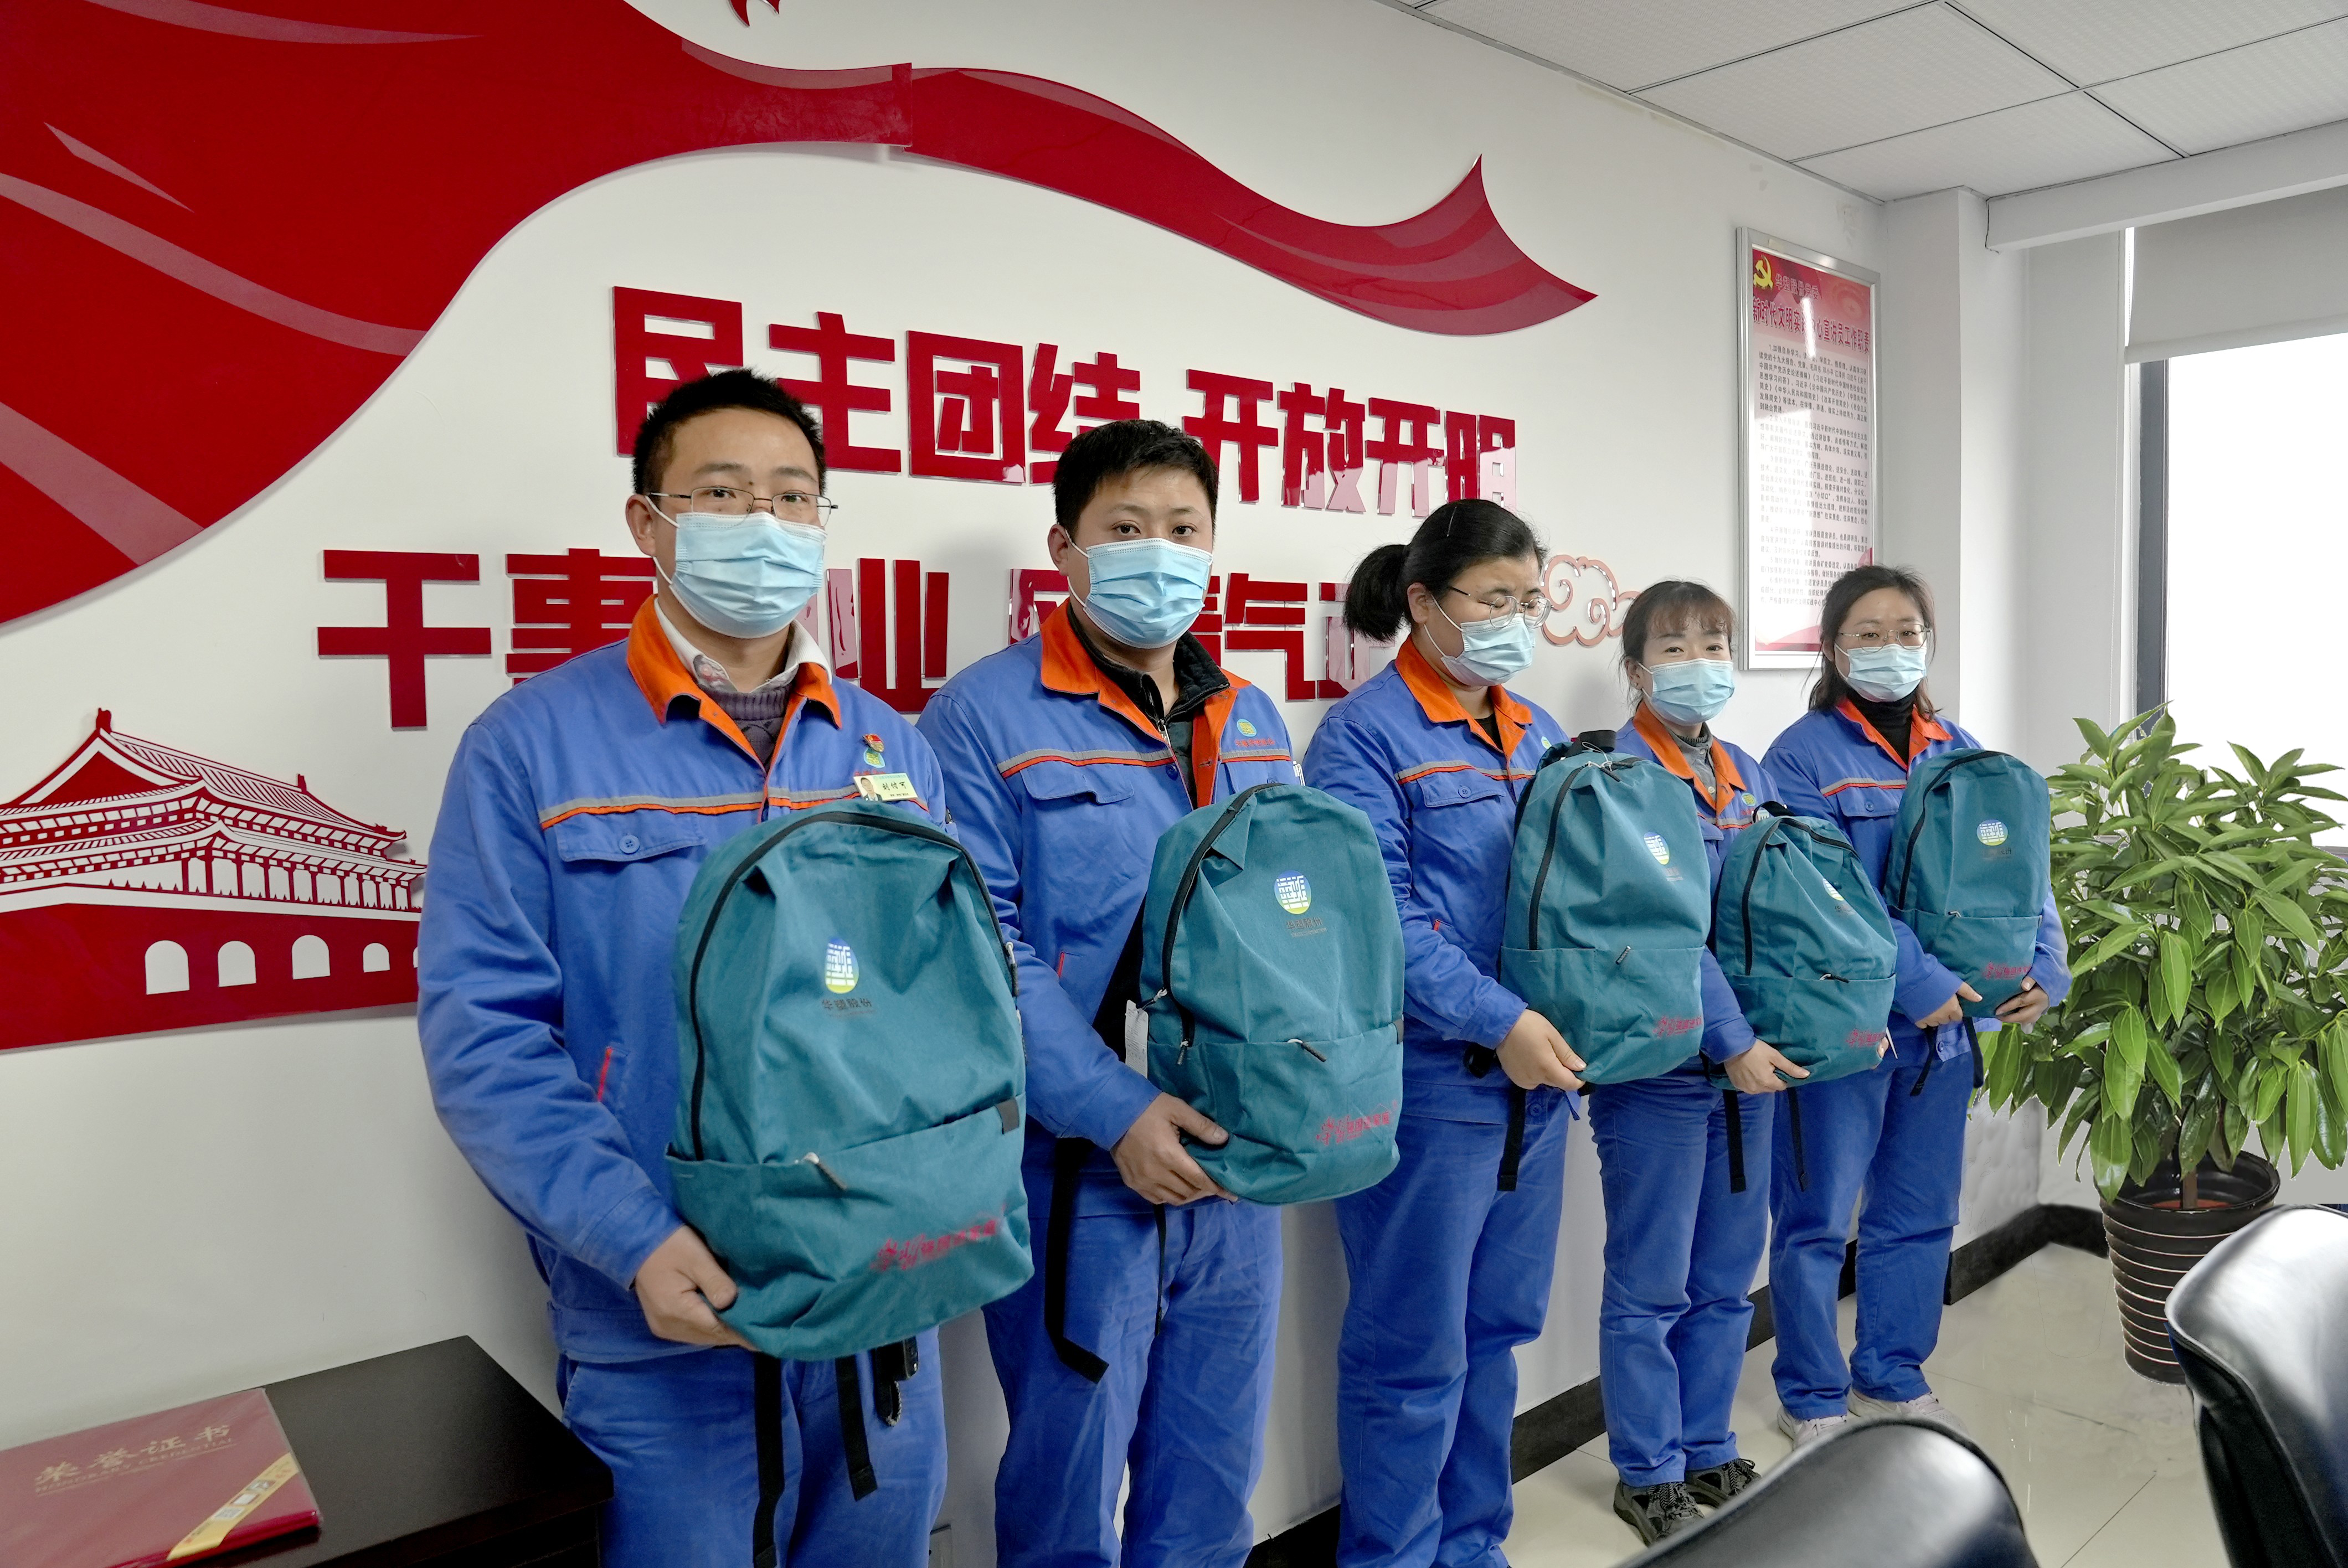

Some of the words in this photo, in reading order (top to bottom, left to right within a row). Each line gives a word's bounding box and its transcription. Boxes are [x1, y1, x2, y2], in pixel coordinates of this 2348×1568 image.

[612, 286, 1140, 486] 民主团结
[1181, 369, 1516, 518] 开放开明
[317, 548, 949, 729] 干事业
[35, 1425, 231, 1485] 荣誉证书
